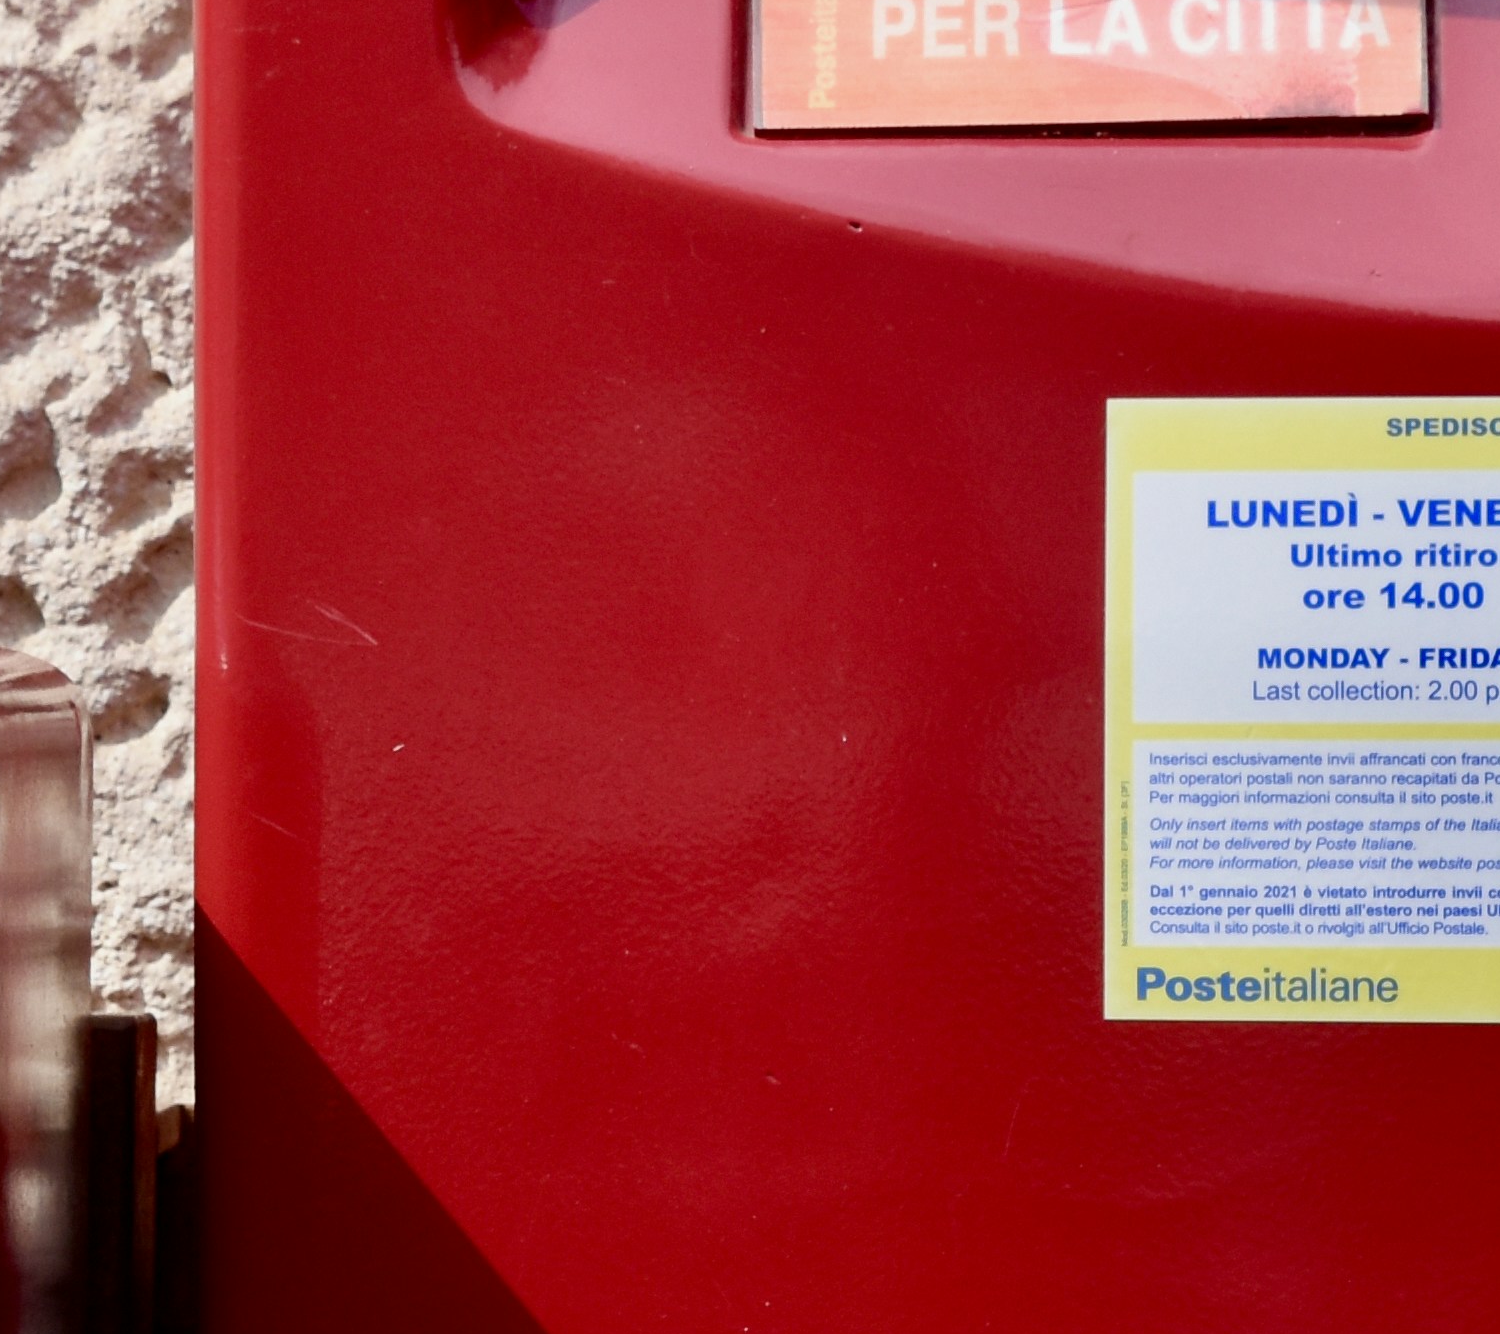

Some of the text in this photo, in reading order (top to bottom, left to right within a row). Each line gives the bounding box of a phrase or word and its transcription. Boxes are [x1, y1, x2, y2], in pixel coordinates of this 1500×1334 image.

[1207, 492, 1359, 529] LUNEDÌ
[1372, 513, 1385, 521] -
[1290, 542, 1499, 568] Ultimo ritiro
[1302, 581, 1485, 610] ore 14.00
[1257, 647, 1391, 670] MONDAY
[1399, 657, 1409, 665] -
[1252, 680, 1301, 702] Last
[1307, 679, 1420, 702] collection:
[1427, 679, 1479, 702] 2.00
[1148, 771, 1175, 786] altri
[1178, 771, 1243, 788] operatori
[1246, 771, 1294, 788] postali
[1296, 773, 1325, 786] non
[1328, 773, 1388, 786] saranno
[1390, 771, 1458, 788] recapitati
[1460, 771, 1480, 786] da
[1148, 789, 1494, 807] Per maggiori informazioni consulta il sito poste.it
[1149, 884, 1174, 899] Dal
[1198, 884, 1259, 902] gennaio
[1263, 884, 1297, 899] 2021
[1303, 884, 1313, 899] è
[1317, 885, 1368, 900] vietato
[1372, 885, 1447, 900] introdurre
[1451, 885, 1483, 900] invii
[1134, 965, 1400, 1005] Posteitaliane
